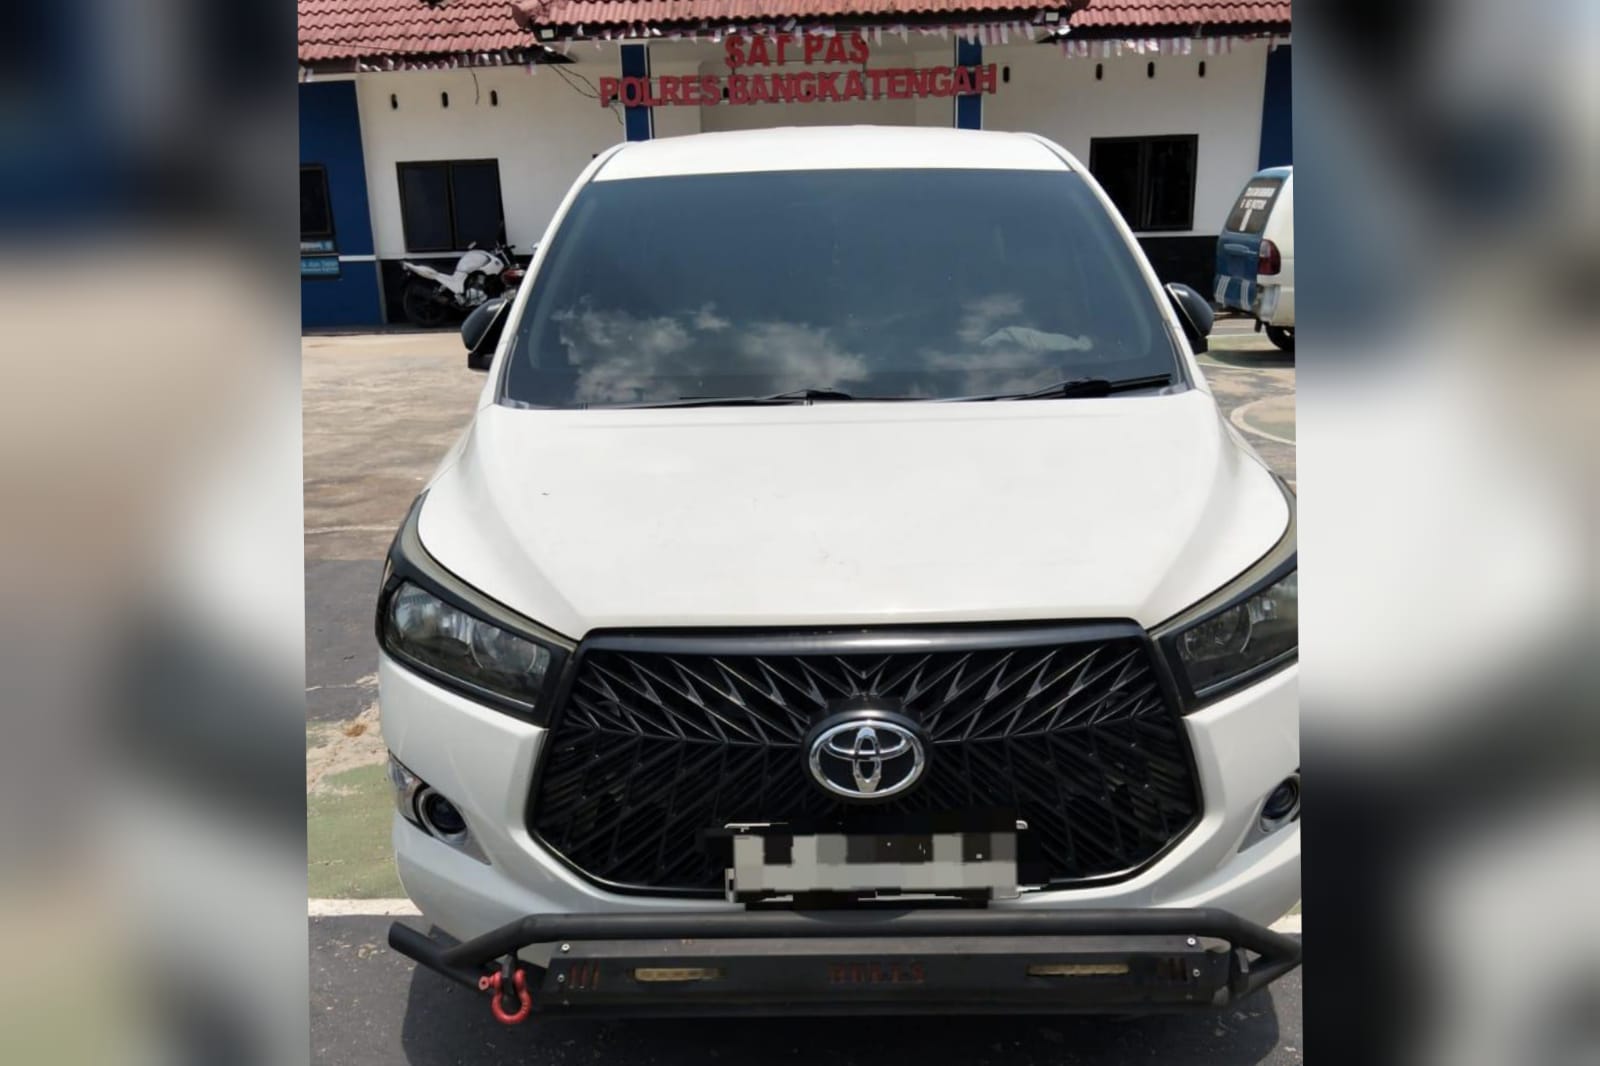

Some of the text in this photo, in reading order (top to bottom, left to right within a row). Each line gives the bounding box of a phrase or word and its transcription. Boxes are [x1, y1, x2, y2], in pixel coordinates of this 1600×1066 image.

[725, 31, 869, 68] SAT PAS
[600, 76, 721, 107] POLRES
